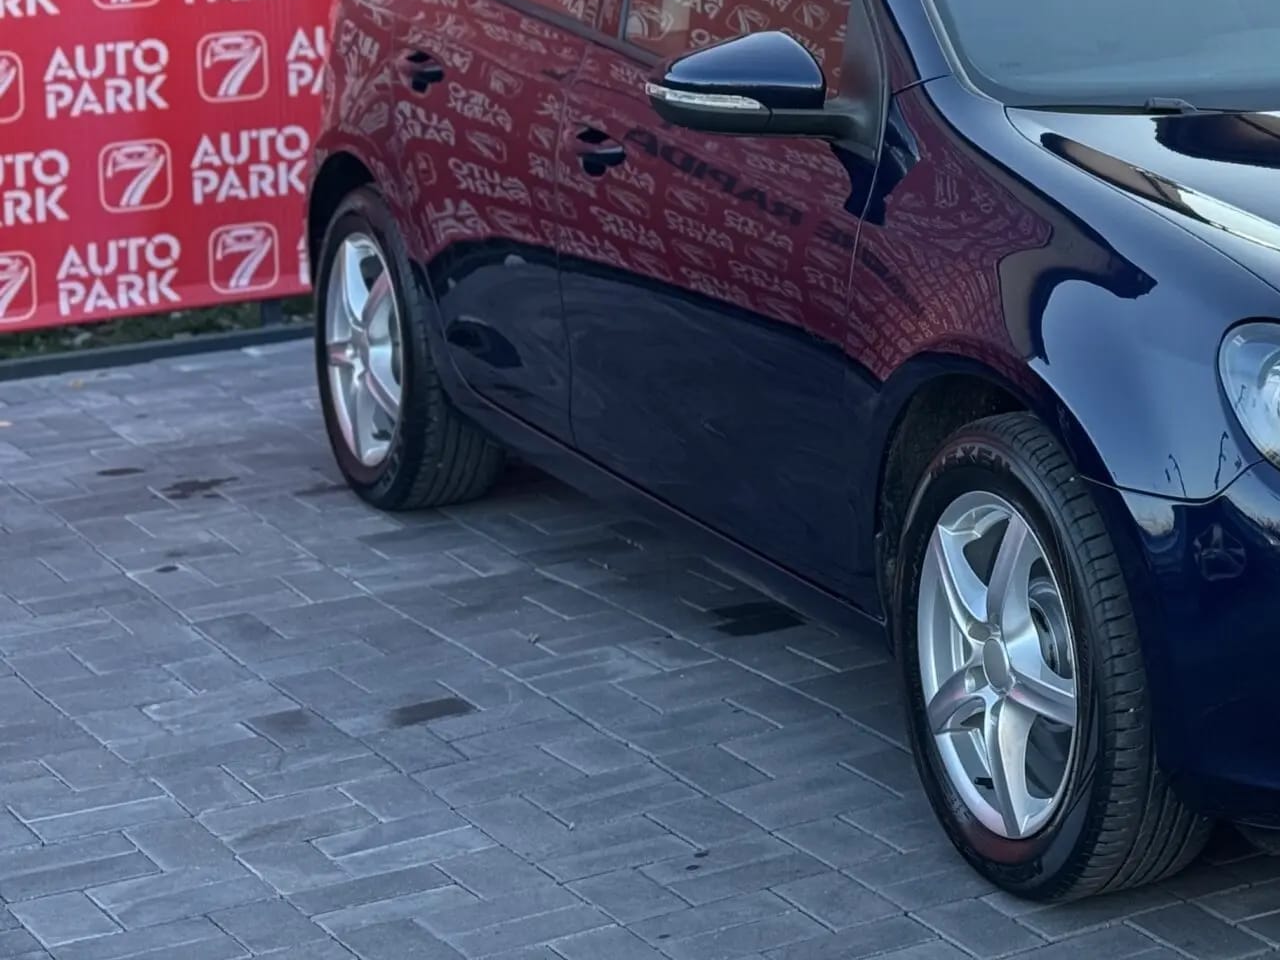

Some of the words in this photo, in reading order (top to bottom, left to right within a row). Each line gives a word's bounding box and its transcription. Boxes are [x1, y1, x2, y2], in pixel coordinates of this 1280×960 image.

[43, 38, 170, 83] AUTO
[44, 72, 169, 120] PARK
[190, 124, 309, 168] AUTO
[191, 158, 307, 205] PARK
[56, 232, 182, 283] AUTO
[57, 267, 182, 318] PARK
